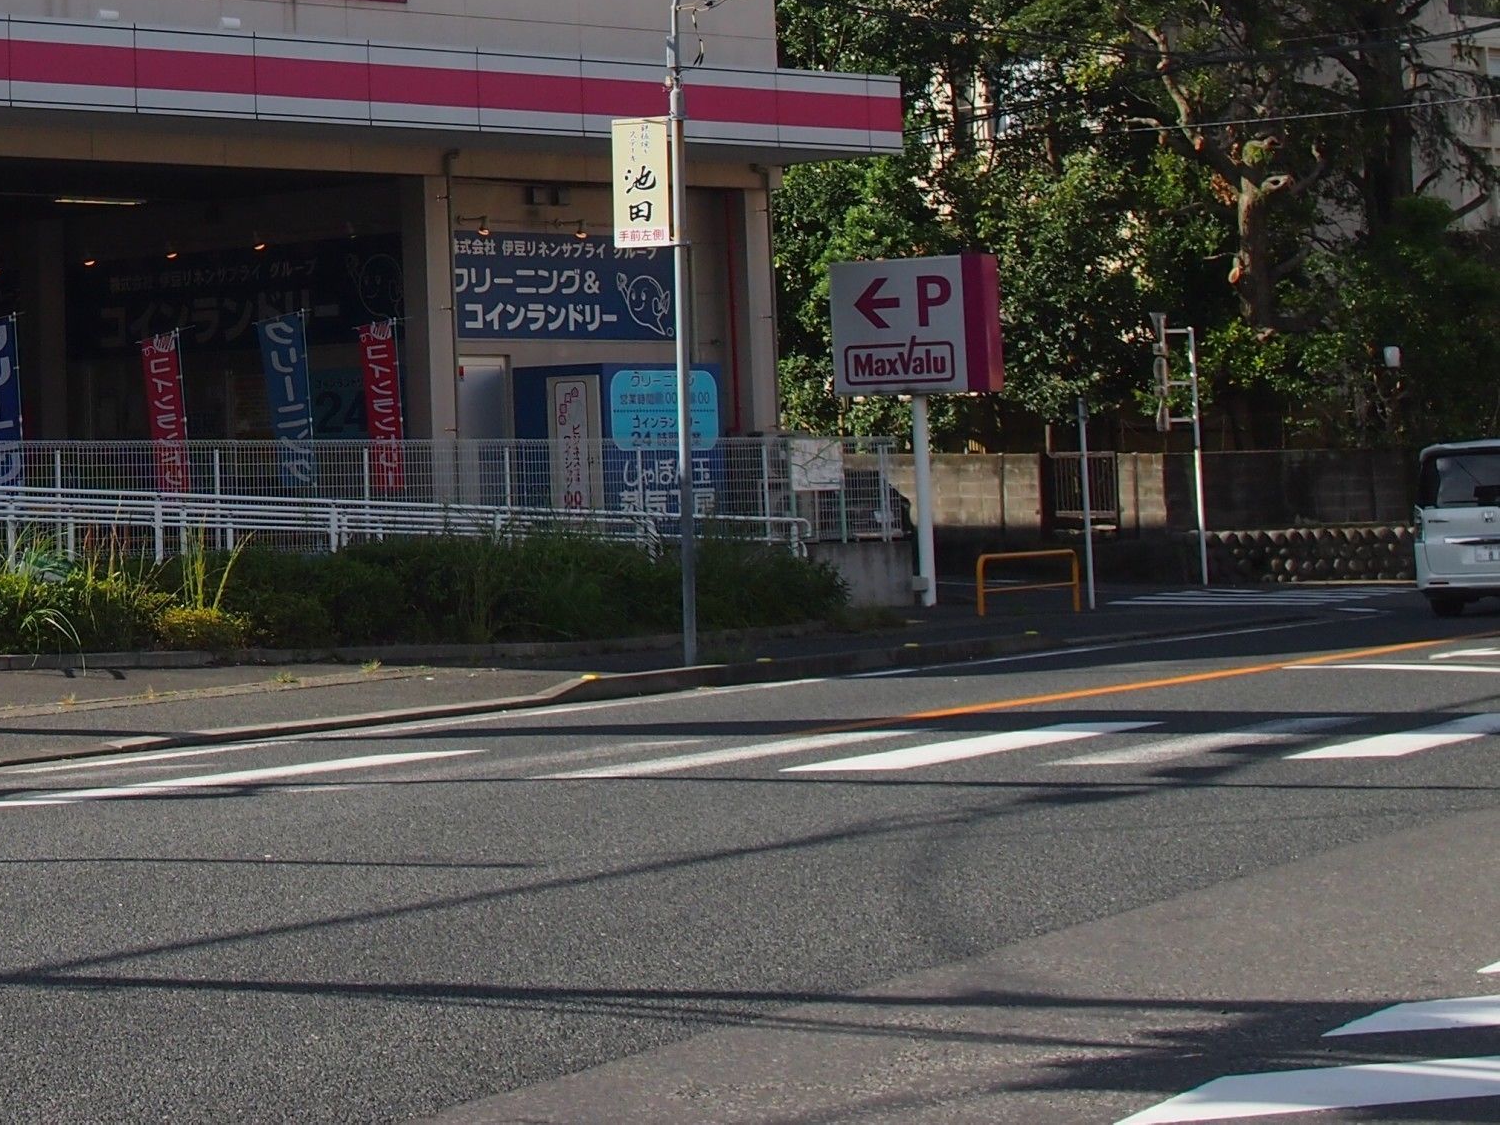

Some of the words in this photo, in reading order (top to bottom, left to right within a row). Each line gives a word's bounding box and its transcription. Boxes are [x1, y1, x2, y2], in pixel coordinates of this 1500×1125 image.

[624, 165, 657, 222] 池田
[618, 228, 665, 243] 手前左側
[465, 302, 618, 332] コインランドリー
[916, 275, 952, 327] P
[853, 335, 946, 377] MaxValu
